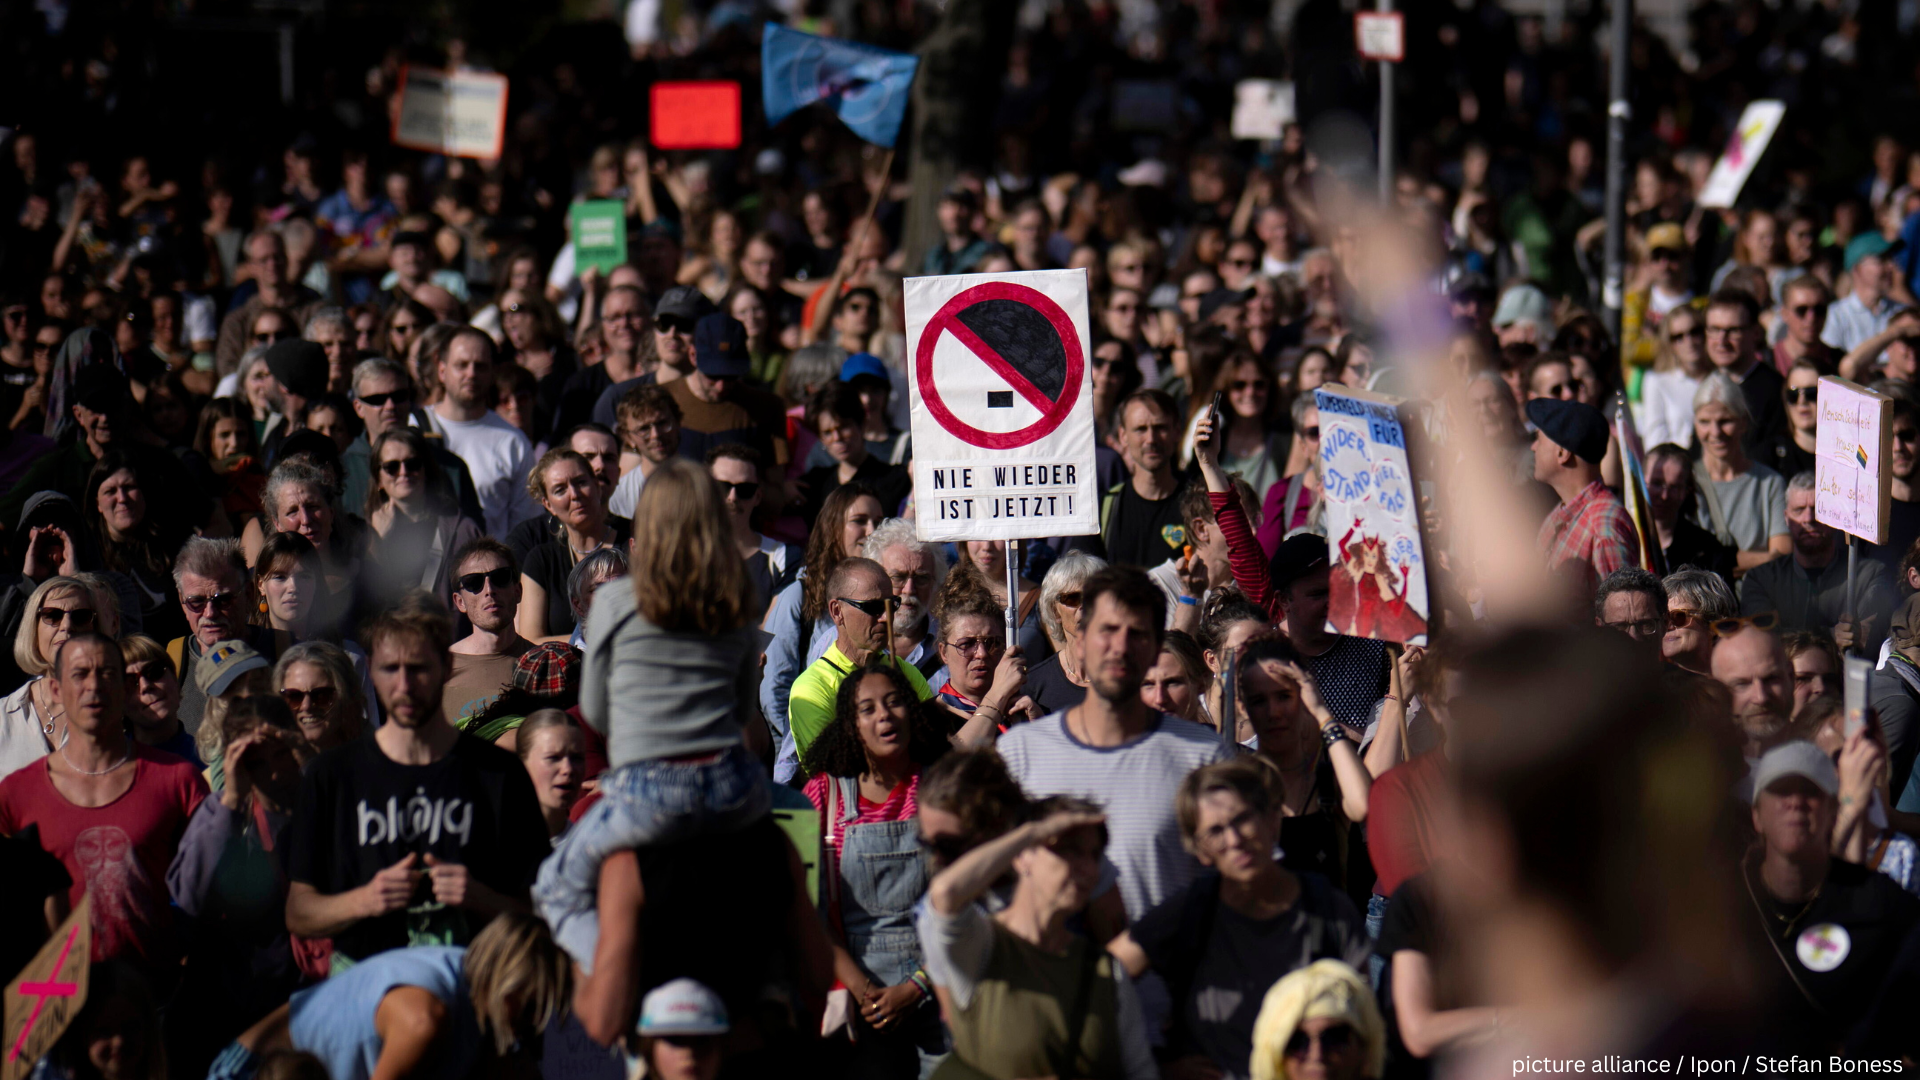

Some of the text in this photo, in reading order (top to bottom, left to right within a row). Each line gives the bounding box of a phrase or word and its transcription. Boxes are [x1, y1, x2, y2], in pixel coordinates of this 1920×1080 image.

[934, 464, 1077, 489] NIE WIEDER
[1323, 468, 1370, 500] STAND
[940, 499, 973, 520] IST
